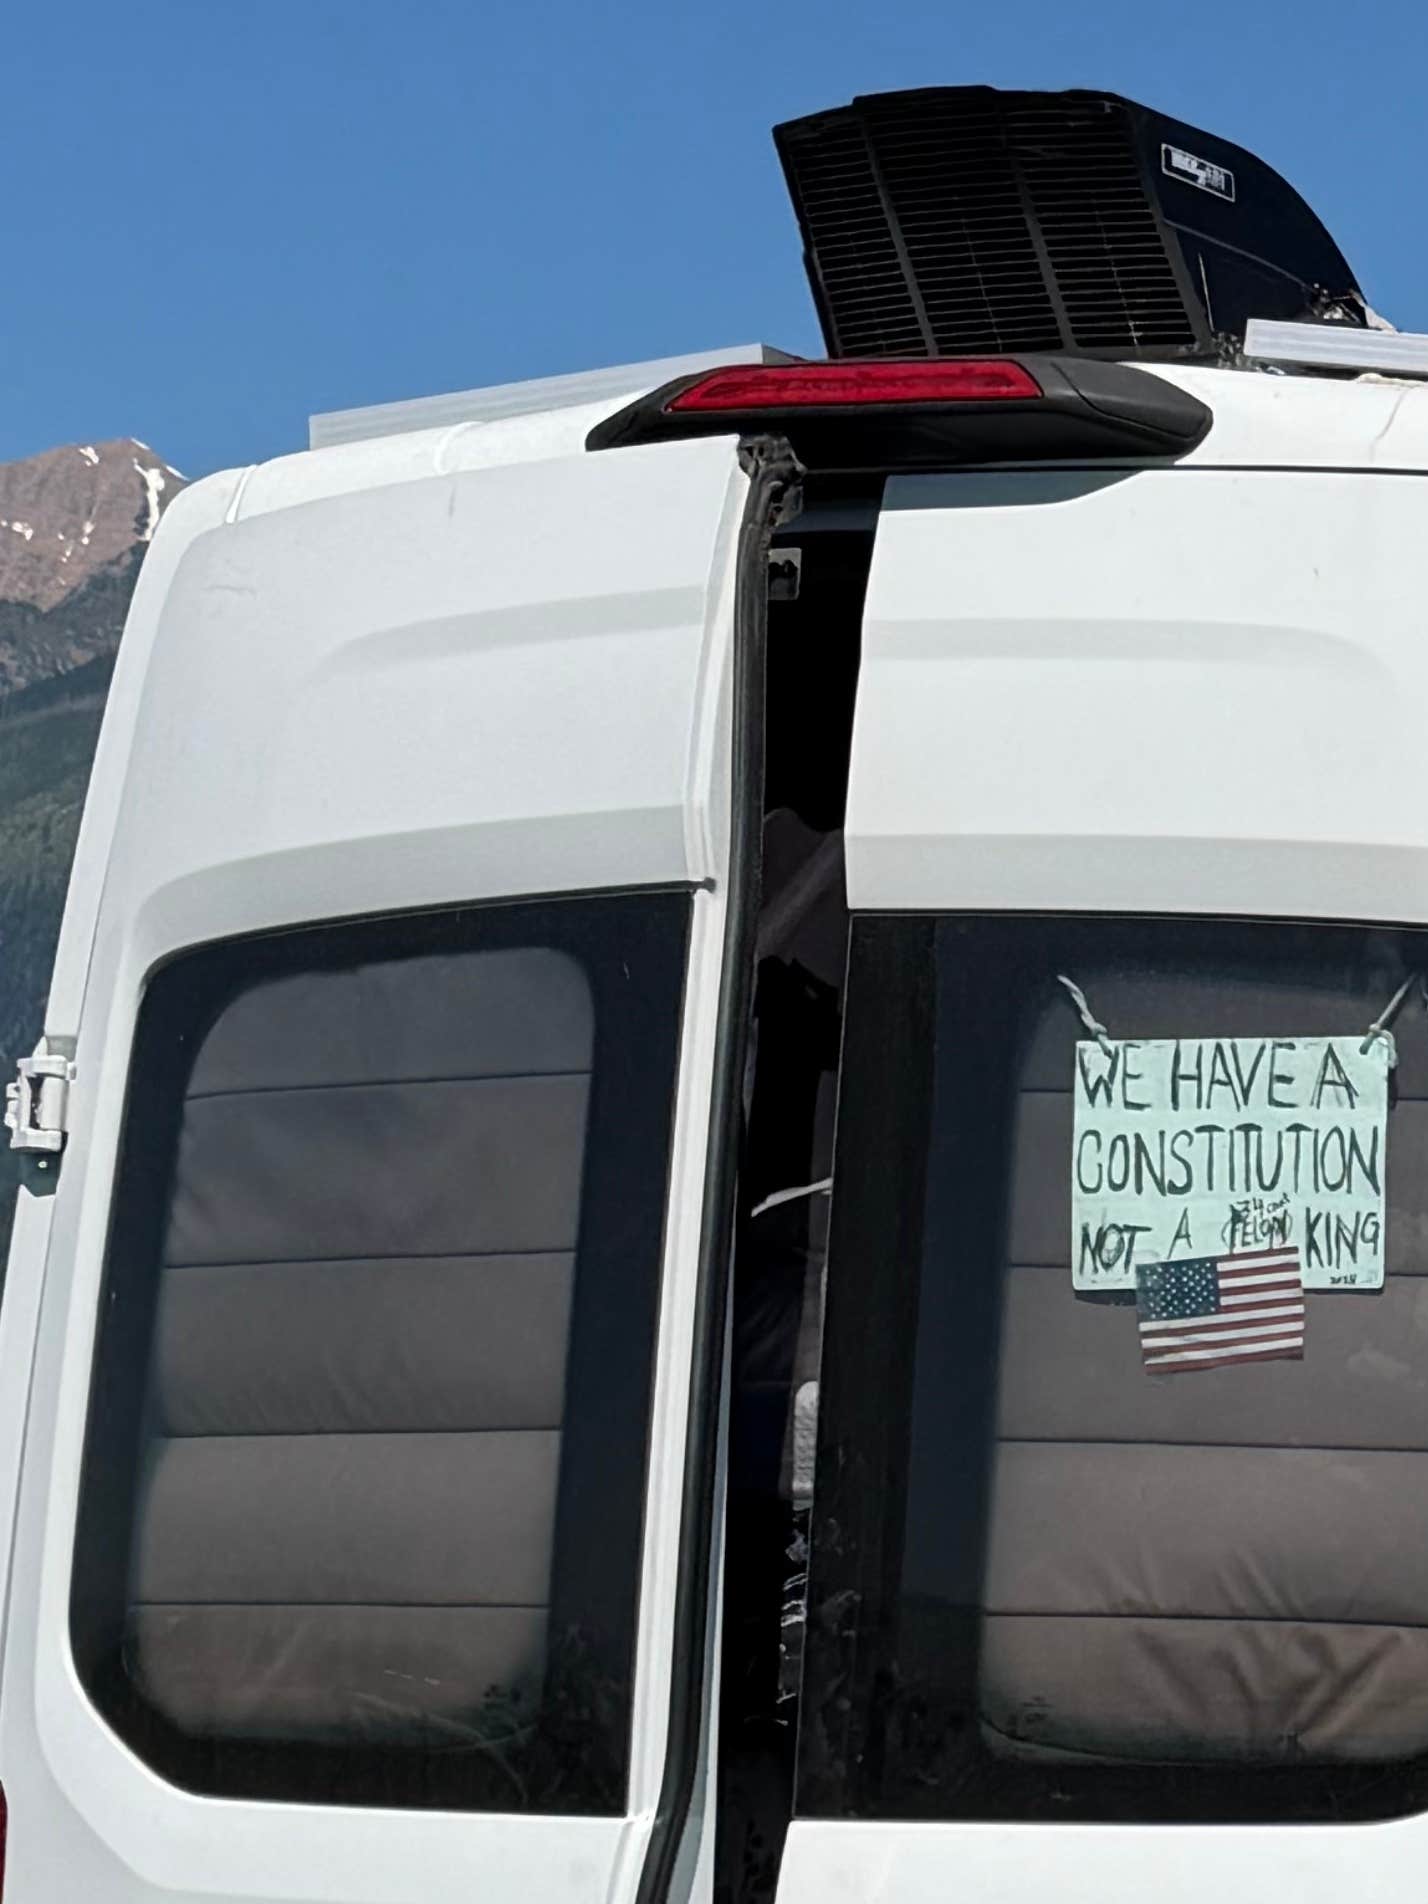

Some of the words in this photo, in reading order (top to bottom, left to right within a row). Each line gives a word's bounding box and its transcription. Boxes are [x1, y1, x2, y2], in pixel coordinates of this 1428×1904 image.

[1078, 1043, 1152, 1110] WE
[1171, 1042, 1301, 1112] HAVE
[1310, 1042, 1360, 1110] A
[1076, 1122, 1381, 1196] CONSTITUTION
[1078, 1222, 1152, 1276] NOT
[1166, 1208, 1194, 1260] A
[1305, 1207, 1381, 1269] KING
